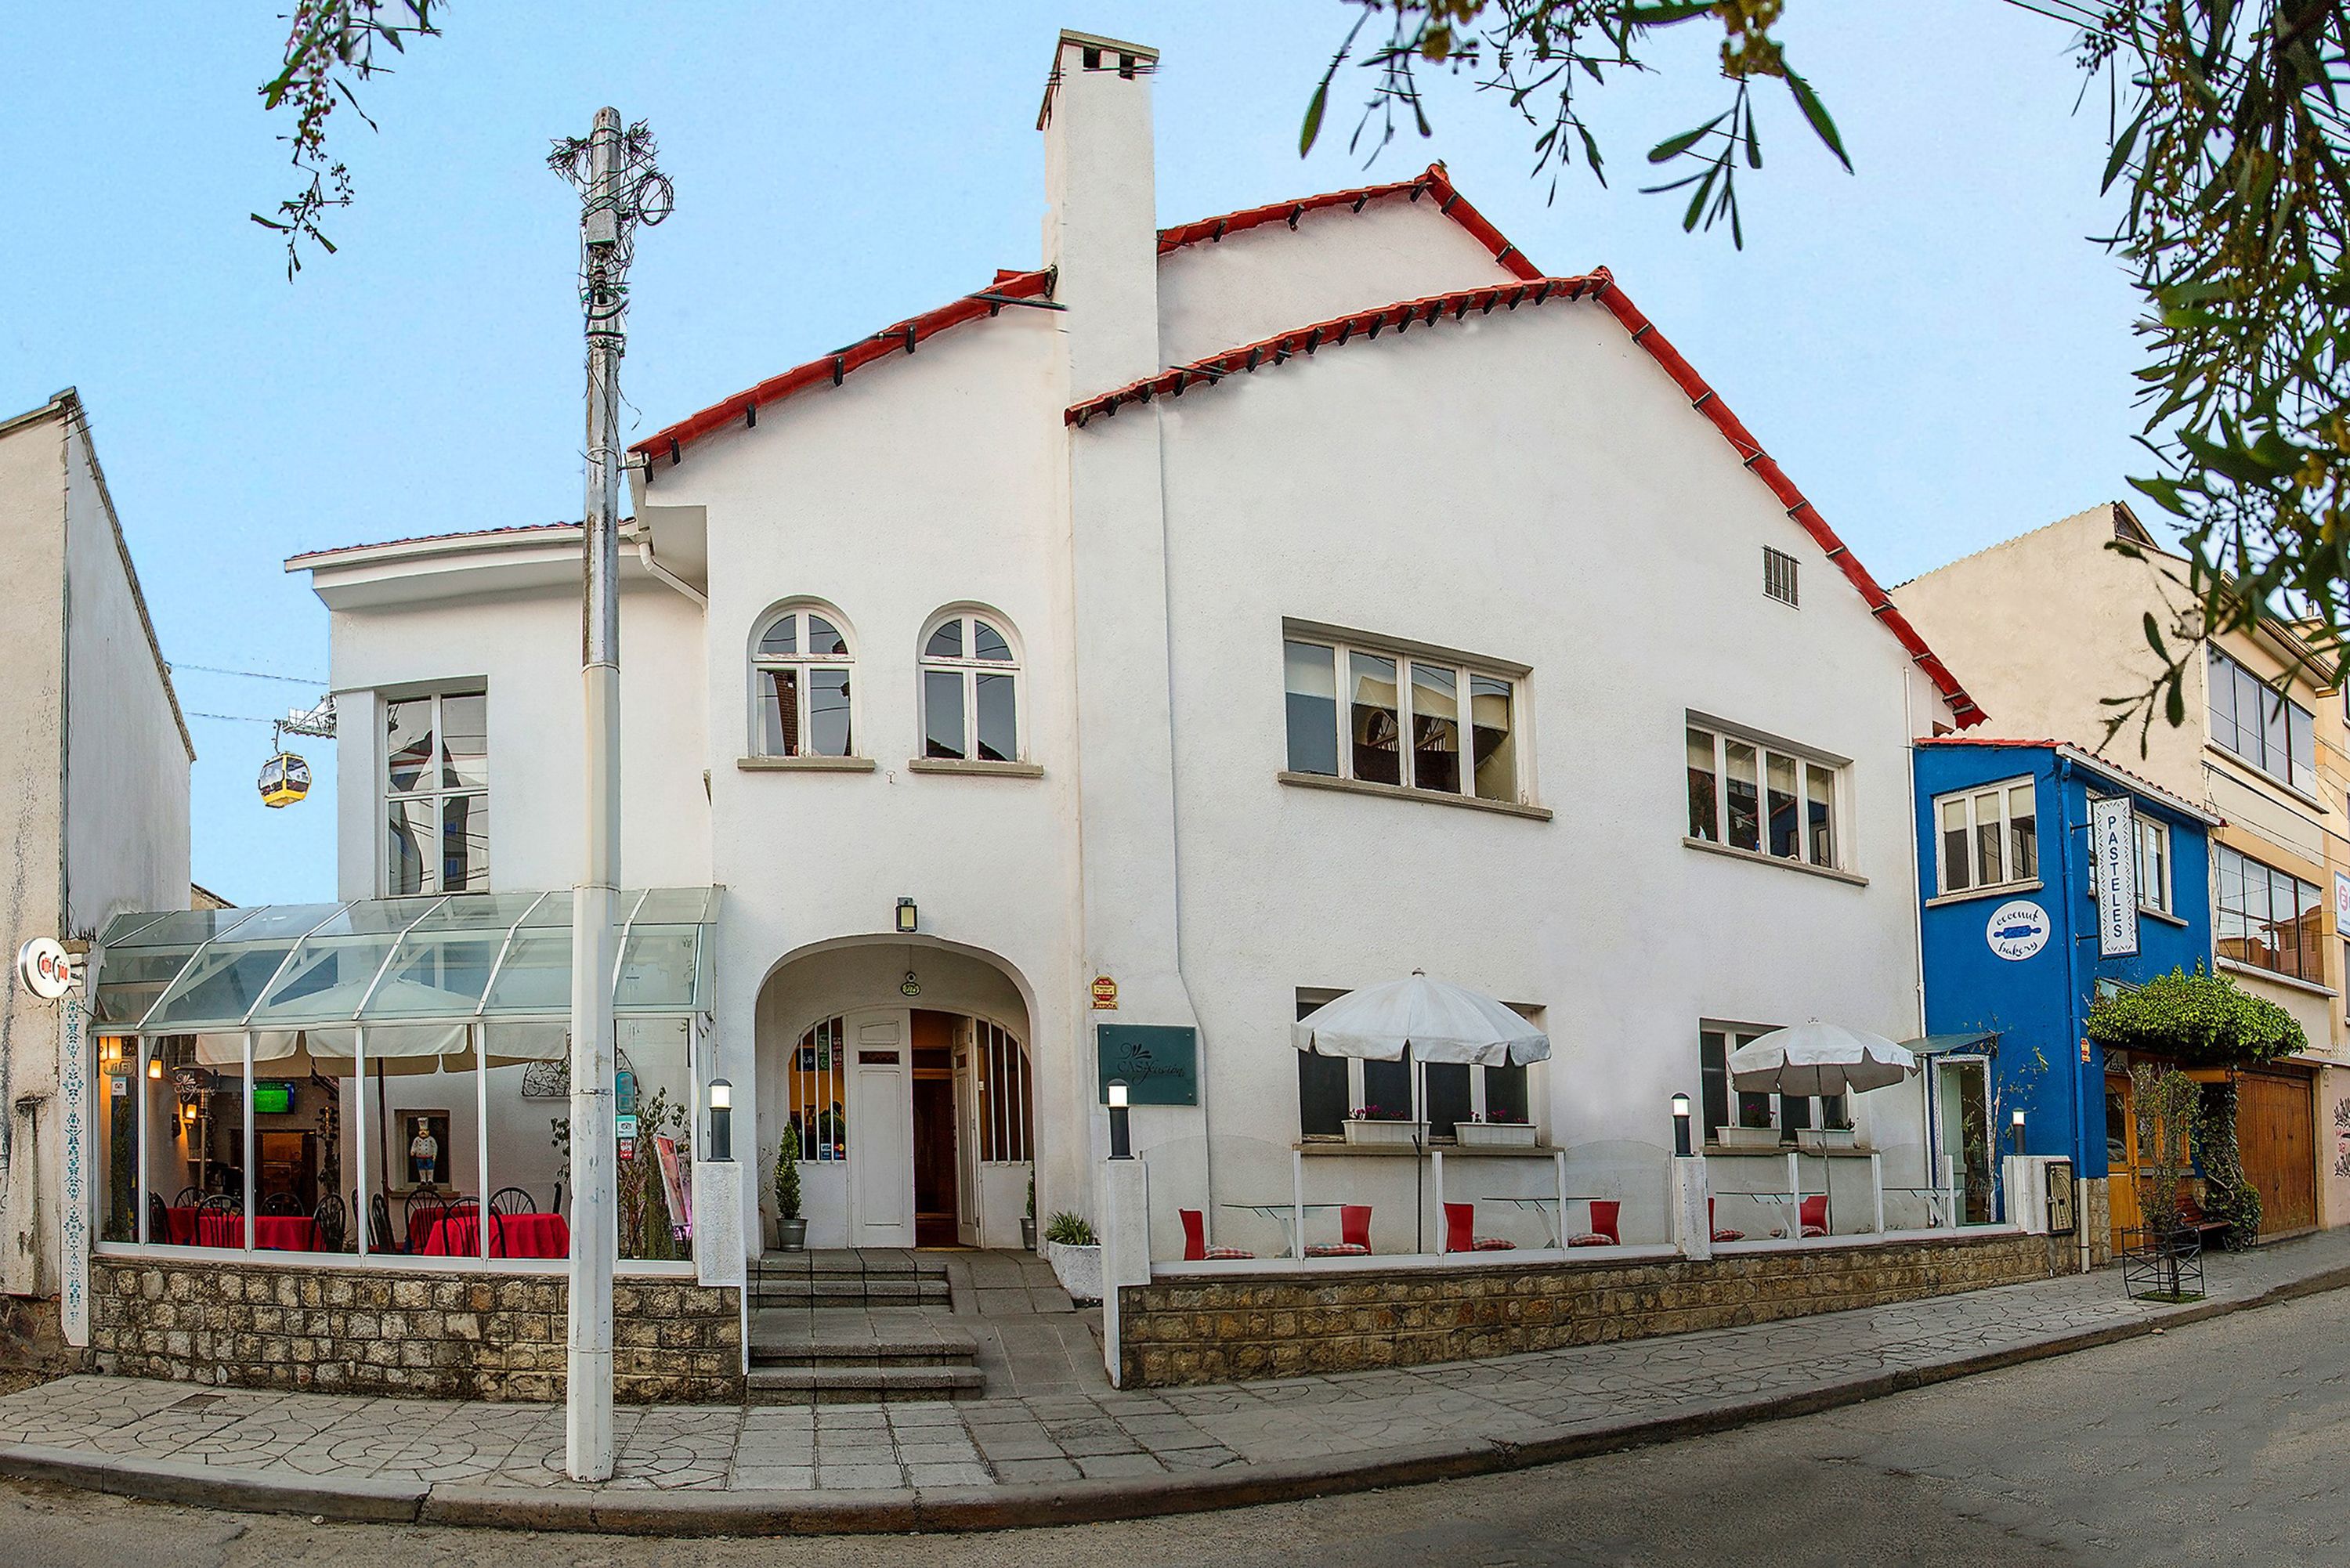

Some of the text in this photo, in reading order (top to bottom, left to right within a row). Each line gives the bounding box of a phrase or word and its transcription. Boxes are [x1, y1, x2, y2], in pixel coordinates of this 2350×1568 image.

[2107, 815, 2123, 938] PASTELES
[1996, 909, 2039, 926] coconut
[1998, 941, 2038, 957] bakery
